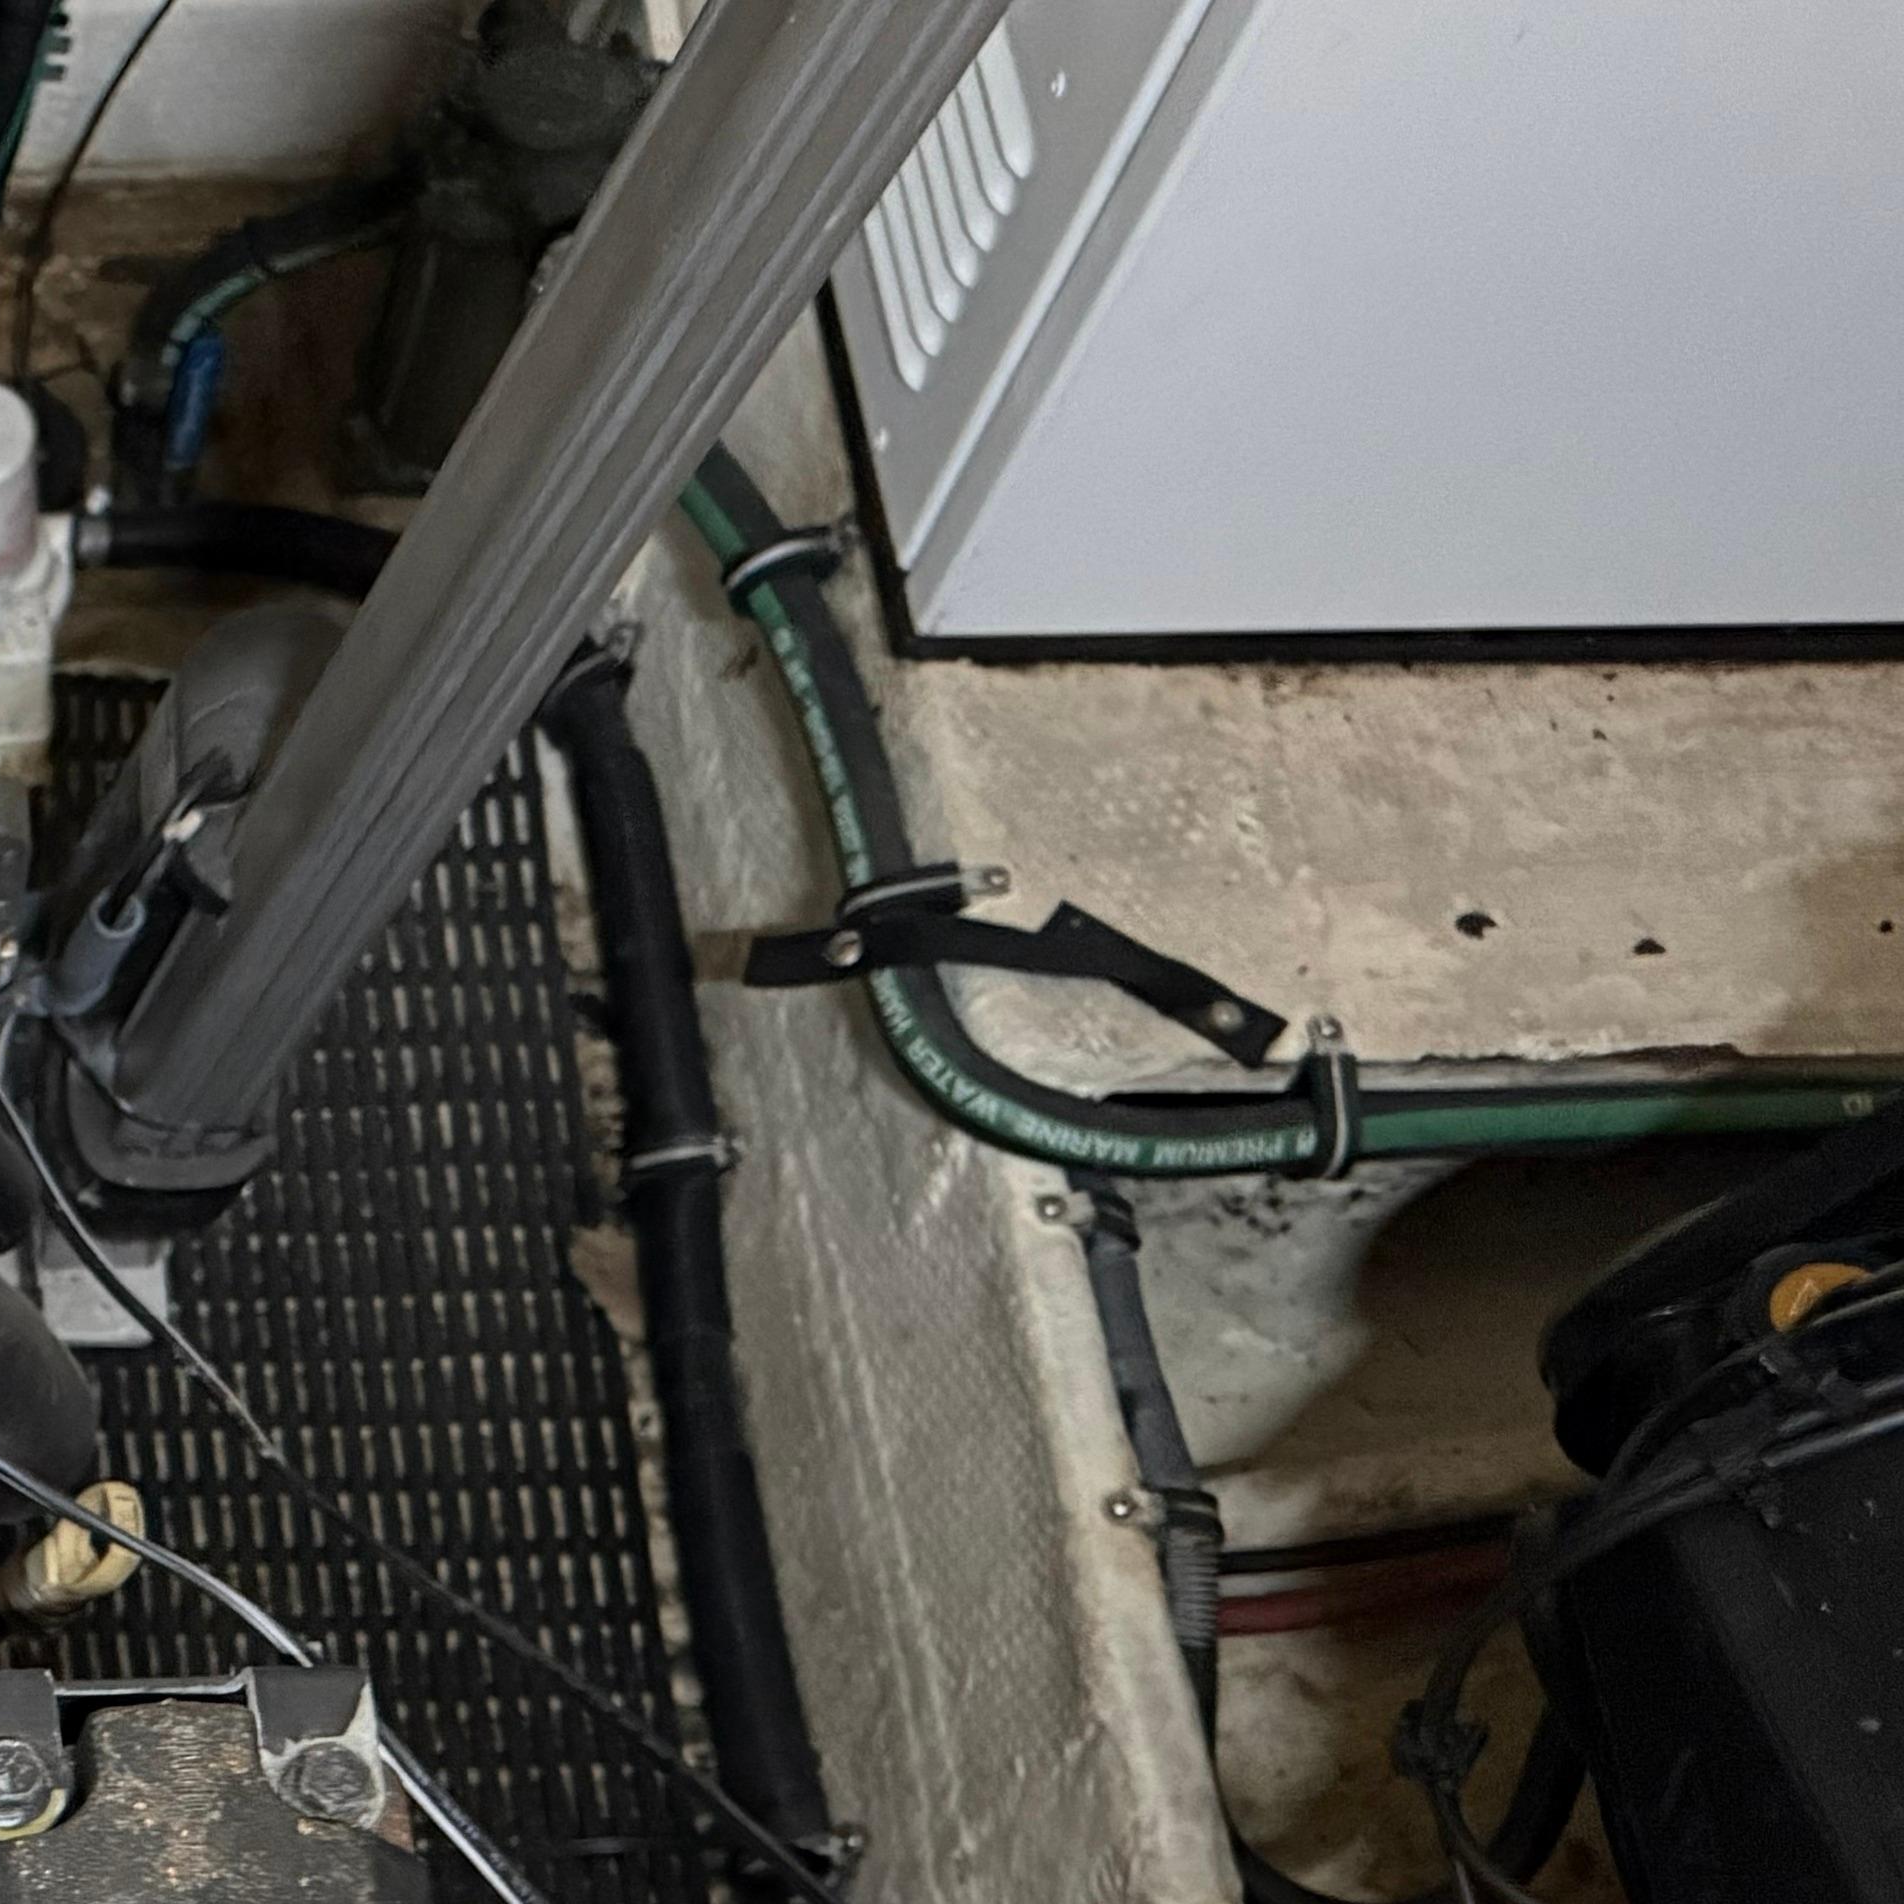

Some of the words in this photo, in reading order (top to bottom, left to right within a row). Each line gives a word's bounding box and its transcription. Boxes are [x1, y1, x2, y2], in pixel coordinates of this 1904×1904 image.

[908, 1034, 1000, 1122] WATER
[1013, 1115, 1139, 1164] MARINE
[1153, 1133, 1285, 1165] PREMIUM
